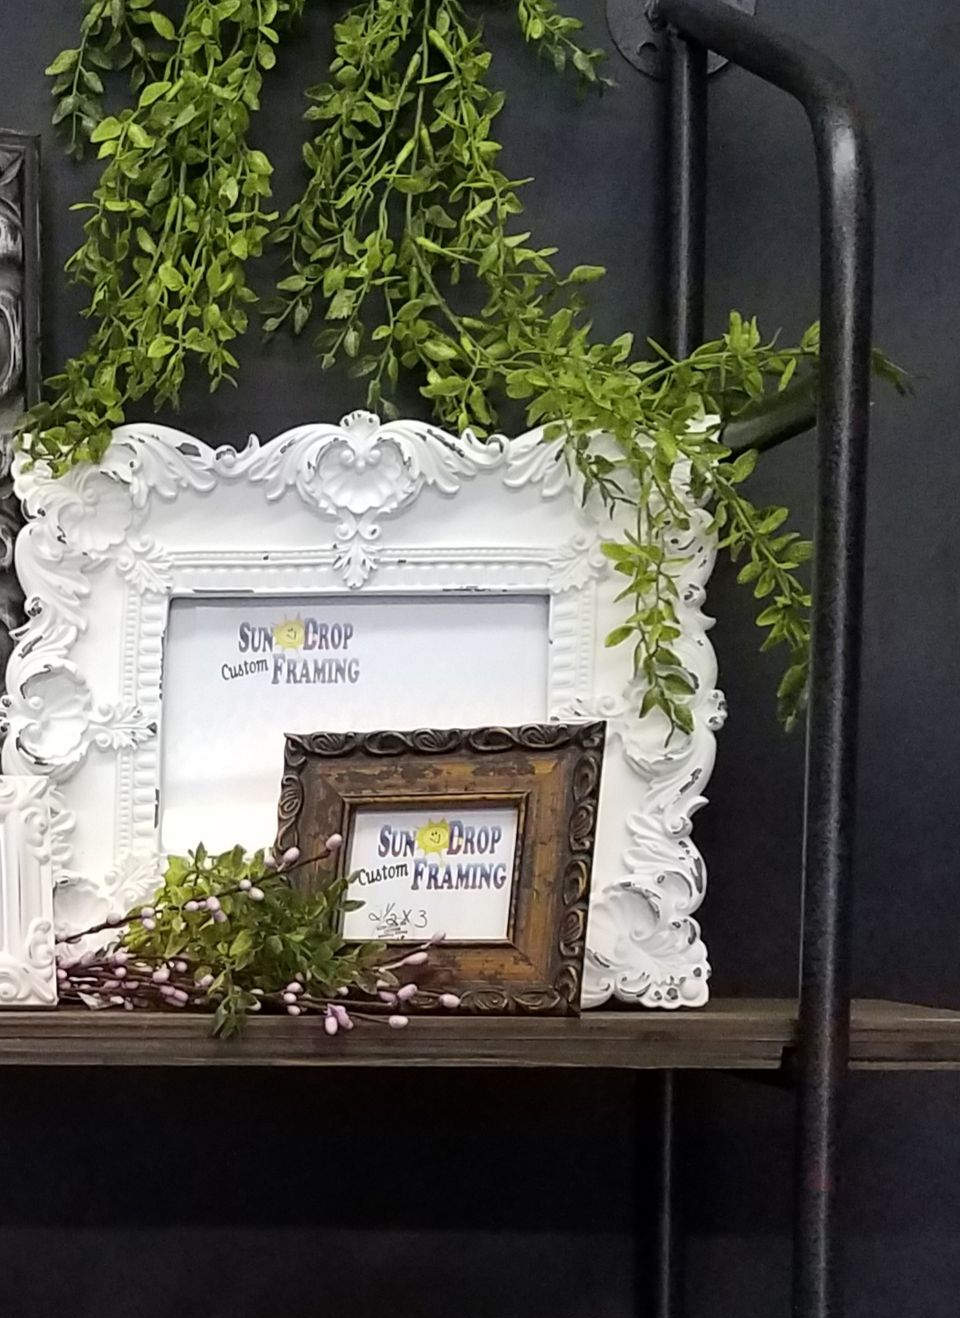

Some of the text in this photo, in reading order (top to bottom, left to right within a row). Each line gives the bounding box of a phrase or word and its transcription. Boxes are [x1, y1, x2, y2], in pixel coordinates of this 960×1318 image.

[238, 617, 354, 653] SUN DROP
[221, 653, 360, 685] Custom FRAMING
[378, 820, 502, 858] SUN DROP
[358, 858, 507, 890] Custom FRAMING
